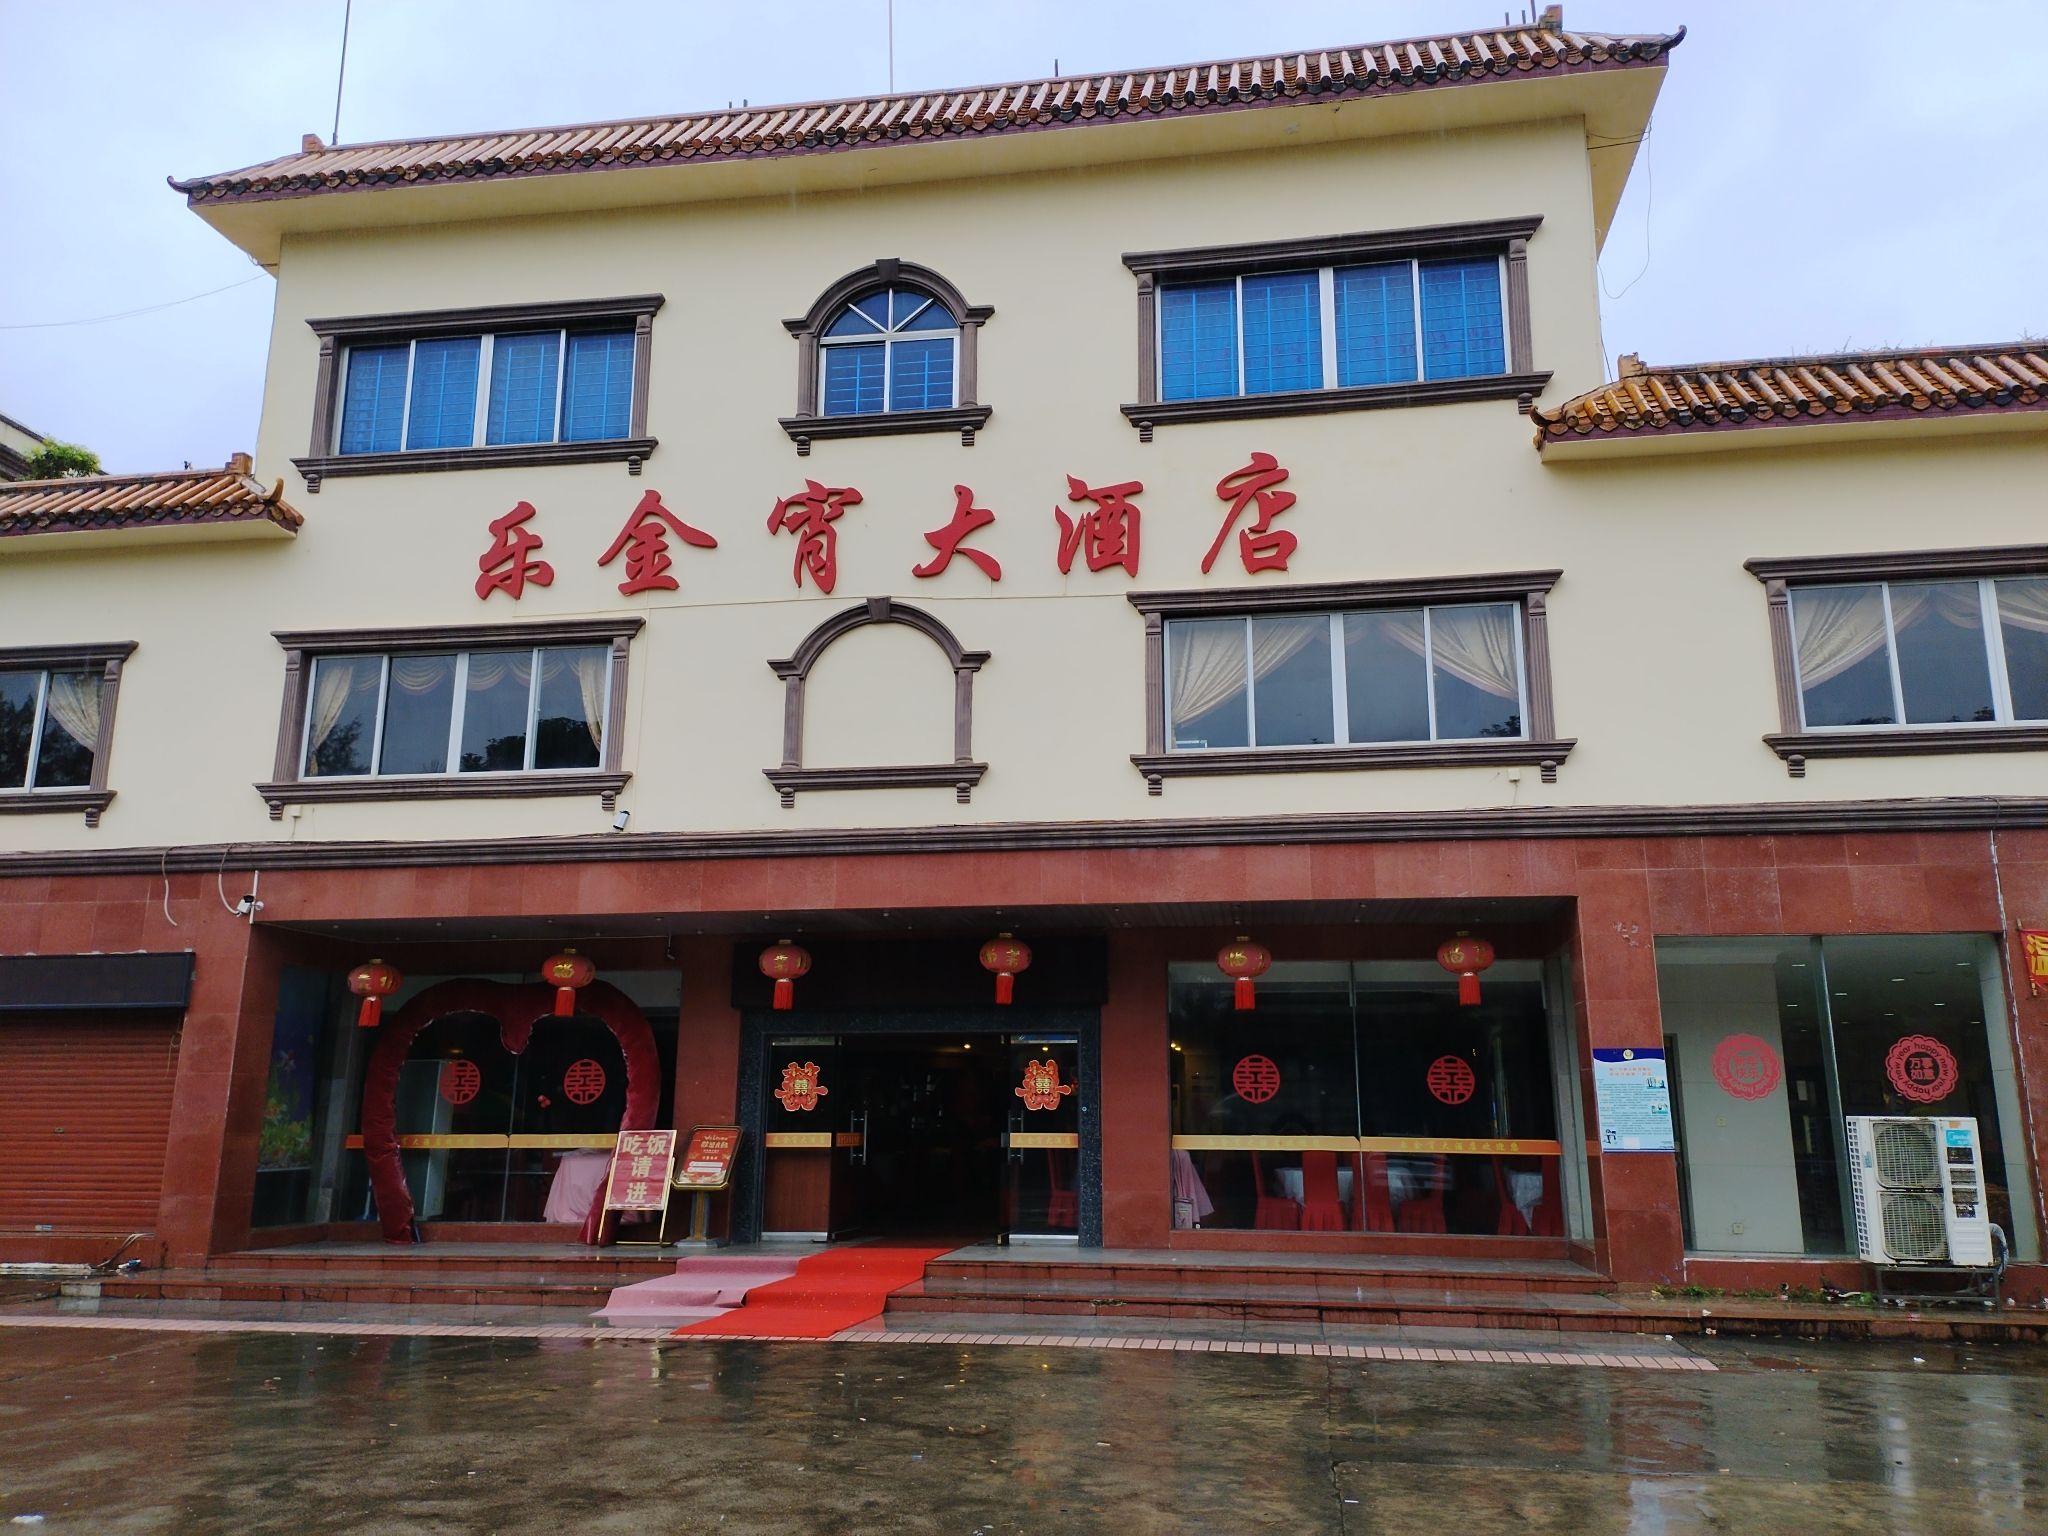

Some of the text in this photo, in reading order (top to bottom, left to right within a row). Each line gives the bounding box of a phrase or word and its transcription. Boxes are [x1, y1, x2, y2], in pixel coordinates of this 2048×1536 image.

[475, 452, 1298, 600] 乐金宵大酒店
[623, 1134, 668, 1156] 吃饭
[631, 1156, 652, 1178] 请
[625, 1182, 648, 1203] 进
